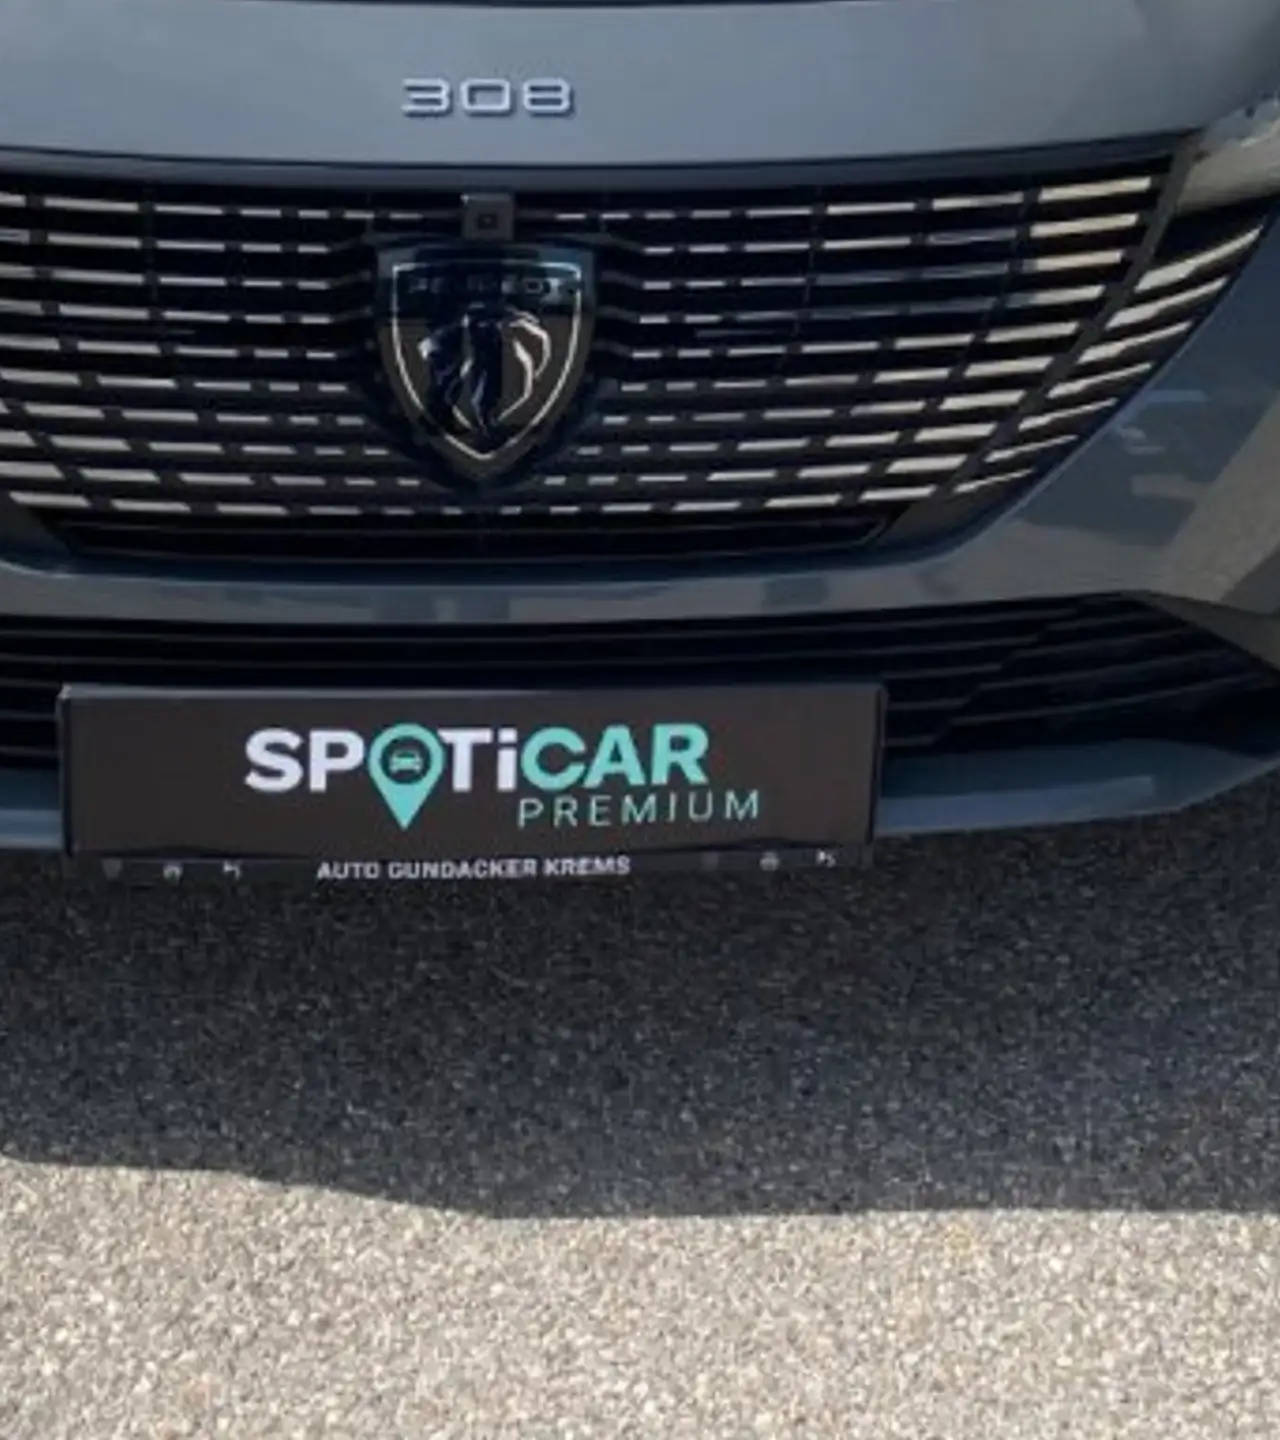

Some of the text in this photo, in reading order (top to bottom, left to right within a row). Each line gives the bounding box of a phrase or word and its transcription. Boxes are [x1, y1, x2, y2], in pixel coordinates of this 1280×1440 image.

[401, 77, 572, 116] 308
[517, 789, 759, 829] PREMIUM
[317, 854, 631, 880] AUTO GUNDACKER KREMS
